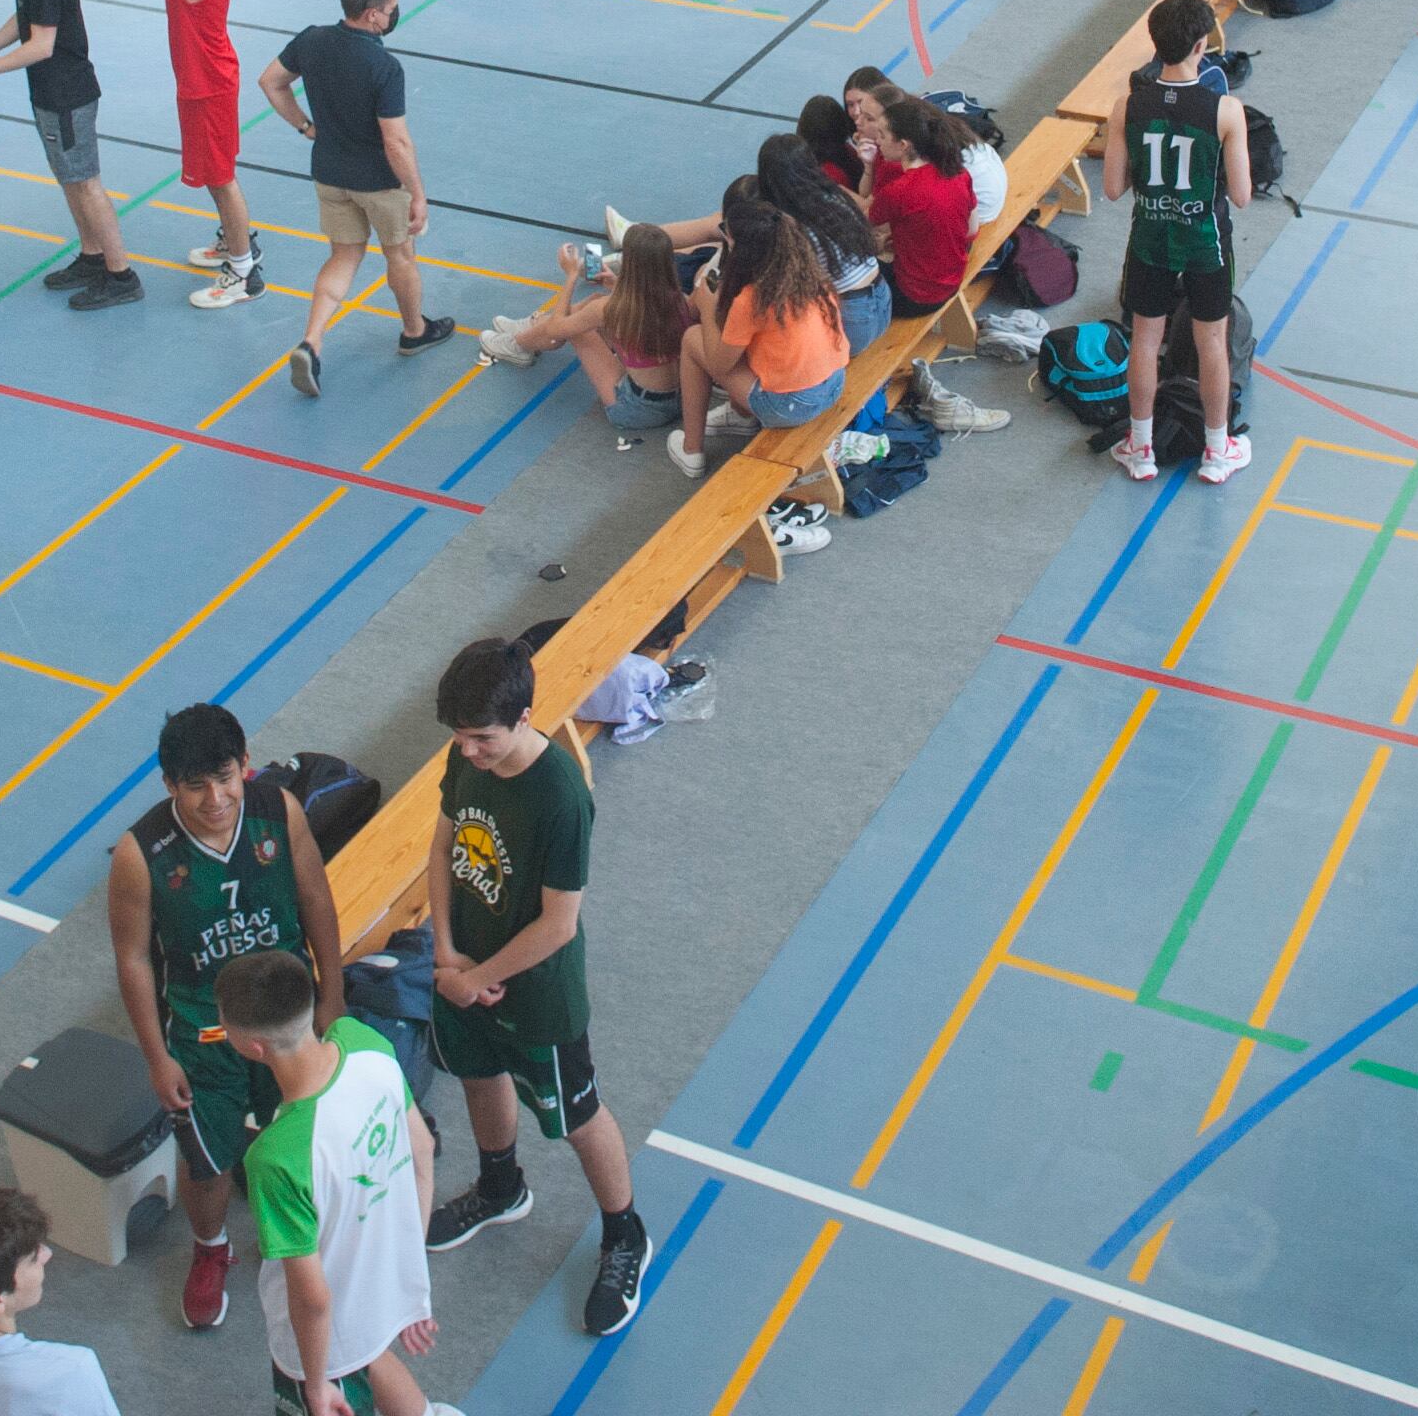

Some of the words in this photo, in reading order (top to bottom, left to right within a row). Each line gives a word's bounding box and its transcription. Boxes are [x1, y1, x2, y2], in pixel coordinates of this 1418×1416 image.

[1142, 131, 1196, 190] 11
[220, 879, 240, 910] 7
[191, 923, 280, 972] HUESCA
[200, 907, 271, 946] PEÑAS
